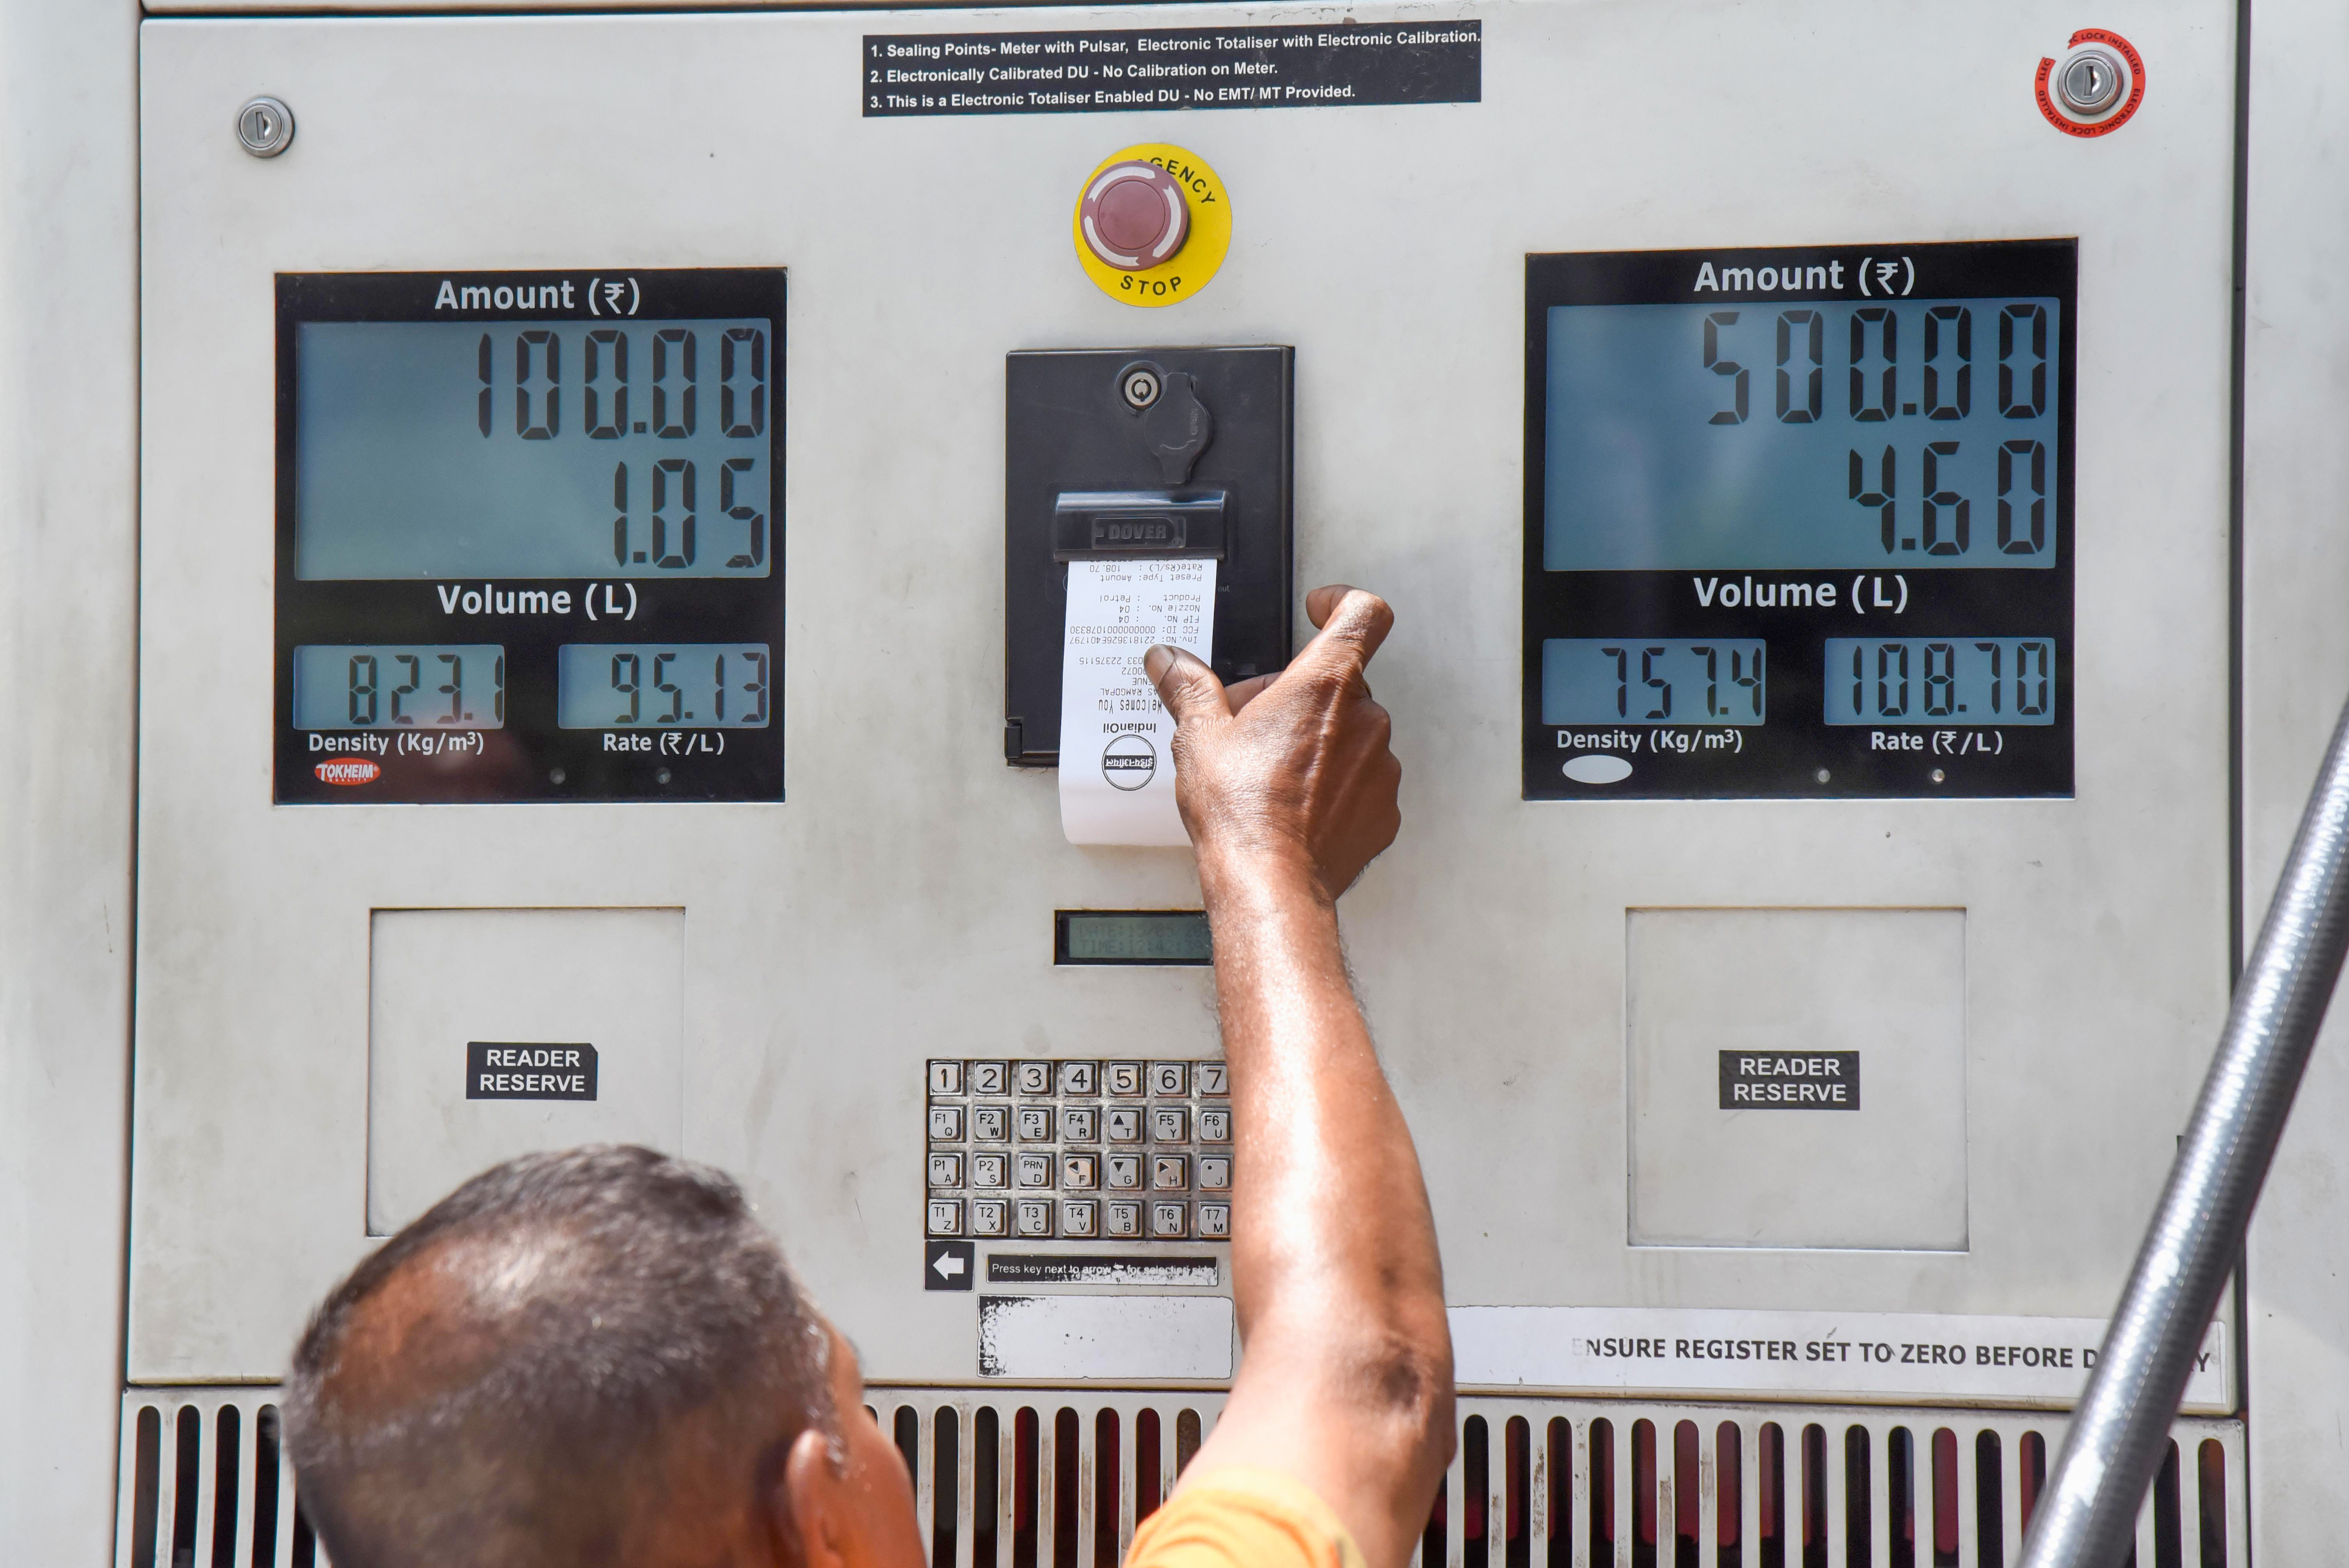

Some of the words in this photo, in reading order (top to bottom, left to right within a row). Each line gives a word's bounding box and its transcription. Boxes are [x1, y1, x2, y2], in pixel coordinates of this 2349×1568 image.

[871, 45, 882, 57] 1.
[888, 44, 940, 59] Sealing
[945, 43, 996, 55] Points-
[1001, 43, 1040, 54] Meter
[1045, 41, 1074, 53] with
[1080, 40, 1128, 53] Pulsar,
[1138, 38, 1211, 51] Electronic
[1216, 36, 1278, 49] Totaliser
[1283, 35, 1312, 47] with
[1319, 33, 1392, 46] Electronic
[1397, 30, 1480, 44] Calibration.
[2109, 36, 2141, 75] INSTALLED
[871, 70, 882, 82] 2.
[888, 69, 984, 83] Electronically
[990, 67, 1062, 80] Calibrated
[1068, 66, 1088, 78] DU
[1104, 65, 1122, 77] No
[1128, 64, 1206, 77] Calibration
[1211, 66, 1229, 75] on
[1235, 62, 1277, 74] Meter.
[871, 96, 882, 108] 3.
[887, 96, 917, 107] This
[922, 95, 934, 106] is
[939, 97, 946, 106] a
[952, 93, 1023, 106] Electronic
[1028, 92, 1090, 104] Totaliser
[1095, 90, 1153, 103] Enabled
[1159, 90, 1179, 101] DU
[1194, 89, 1213, 101] No
[1219, 88, 1254, 100] EMT/
[1260, 87, 1281, 99] MT
[1286, 85, 1355, 98] Provided.
[2039, 90, 2068, 130] INSTALLED
[2099, 88, 2140, 133] ELECTRONIC
[2071, 126, 2096, 135] LOCK
[1137, 157, 1216, 204] GENCY
[1694, 261, 1844, 291] Amount
[1859, 257, 1914, 296] (₹)
[1120, 275, 1182, 296] STOP
[435, 281, 574, 309] Amount
[589, 278, 639, 315] (₹)
[1704, 303, 2047, 424] 500.00
[479, 328, 765, 440] 100.00
[1849, 440, 2045, 556] 4.60
[615, 458, 764, 568] 1.05
[1108, 524, 1166, 540] DOVER
[1150, 564, 1202, 572] Rate(Rs/L)
[1139, 574, 1163, 582] Type:
[1694, 576, 1836, 607] Volume
[1852, 576, 1907, 613] (L)
[437, 584, 570, 614] Volume
[586, 583, 637, 620] (L)
[1601, 647, 1761, 719] 757.4
[1853, 642, 2047, 716] 108.70
[349, 655, 503, 725] 823.1
[612, 653, 767, 723] 95.13
[1099, 700, 1113, 714] You
[1120, 700, 1162, 714] Welcomes
[1104, 724, 1156, 733] IndianOil
[310, 733, 389, 755] Density
[604, 734, 651, 751] Rate
[1558, 730, 1641, 752] Density
[1872, 732, 1923, 750] Rate
[1106, 757, 1153, 769] इंडियनऑयल
[487, 1050, 580, 1066] READER
[1741, 1058, 1840, 1075] READER
[480, 1074, 585, 1092] RESERVE
[942, 1069, 947, 1088] 1
[982, 1069, 997, 1088] 2
[1027, 1068, 1041, 1087] 3
[1072, 1069, 1087, 1088] 4
[1117, 1069, 1131, 1088] 5
[1162, 1070, 1176, 1089] 6
[1207, 1070, 1221, 1089] 7
[1734, 1084, 1846, 1101] RESERVE
[936, 1113, 945, 1123] F1
[980, 1114, 994, 1124] F2
[1025, 1114, 1038, 1124] F3
[1070, 1114, 1084, 1124] F4
[1160, 1115, 1174, 1125] F5
[1205, 1115, 1219, 1126] F6
[945, 1128, 952, 1136] Q
[990, 1128, 998, 1136] W
[1034, 1128, 1041, 1137] E
[1079, 1128, 1086, 1137] R
[1125, 1128, 1131, 1137] T
[1171, 1129, 1176, 1138] Y
[1215, 1130, 1222, 1138] U
[935, 1160, 945, 1170] P1
[980, 1161, 993, 1171] P2
[1024, 1161, 1042, 1169] PRN
[945, 1174, 951, 1182] A
[990, 1175, 996, 1183] S
[1034, 1174, 1041, 1183] D
[1124, 1176, 1131, 1184] G
[935, 1207, 944, 1217] T1
[980, 1207, 993, 1218] T2
[1025, 1207, 1038, 1218] T3
[1069, 1208, 1084, 1218] T4
[1114, 1209, 1128, 1218] T5
[1160, 1209, 1174, 1220] T6
[1206, 1209, 1220, 1220] T7
[944, 1221, 951, 1229] Z
[989, 1221, 996, 1230] X
[1034, 1222, 1041, 1230] C
[1079, 1222, 1086, 1231] V
[1124, 1222, 1131, 1231] B
[1170, 1223, 1177, 1232] N
[1214, 1223, 1223, 1232] M
[992, 1264, 1020, 1273] Press
[1024, 1264, 1041, 1275] key
[1045, 1265, 1066, 1273] next
[1069, 1265, 1079, 1273] to
[1676, 1339, 1798, 1360] REGISTER
[1806, 1342, 1851, 1362] SET
[1859, 1343, 1892, 1362] TO
[1901, 1344, 1966, 1364] ZERO
[1976, 1346, 2073, 1368] BEFORE
